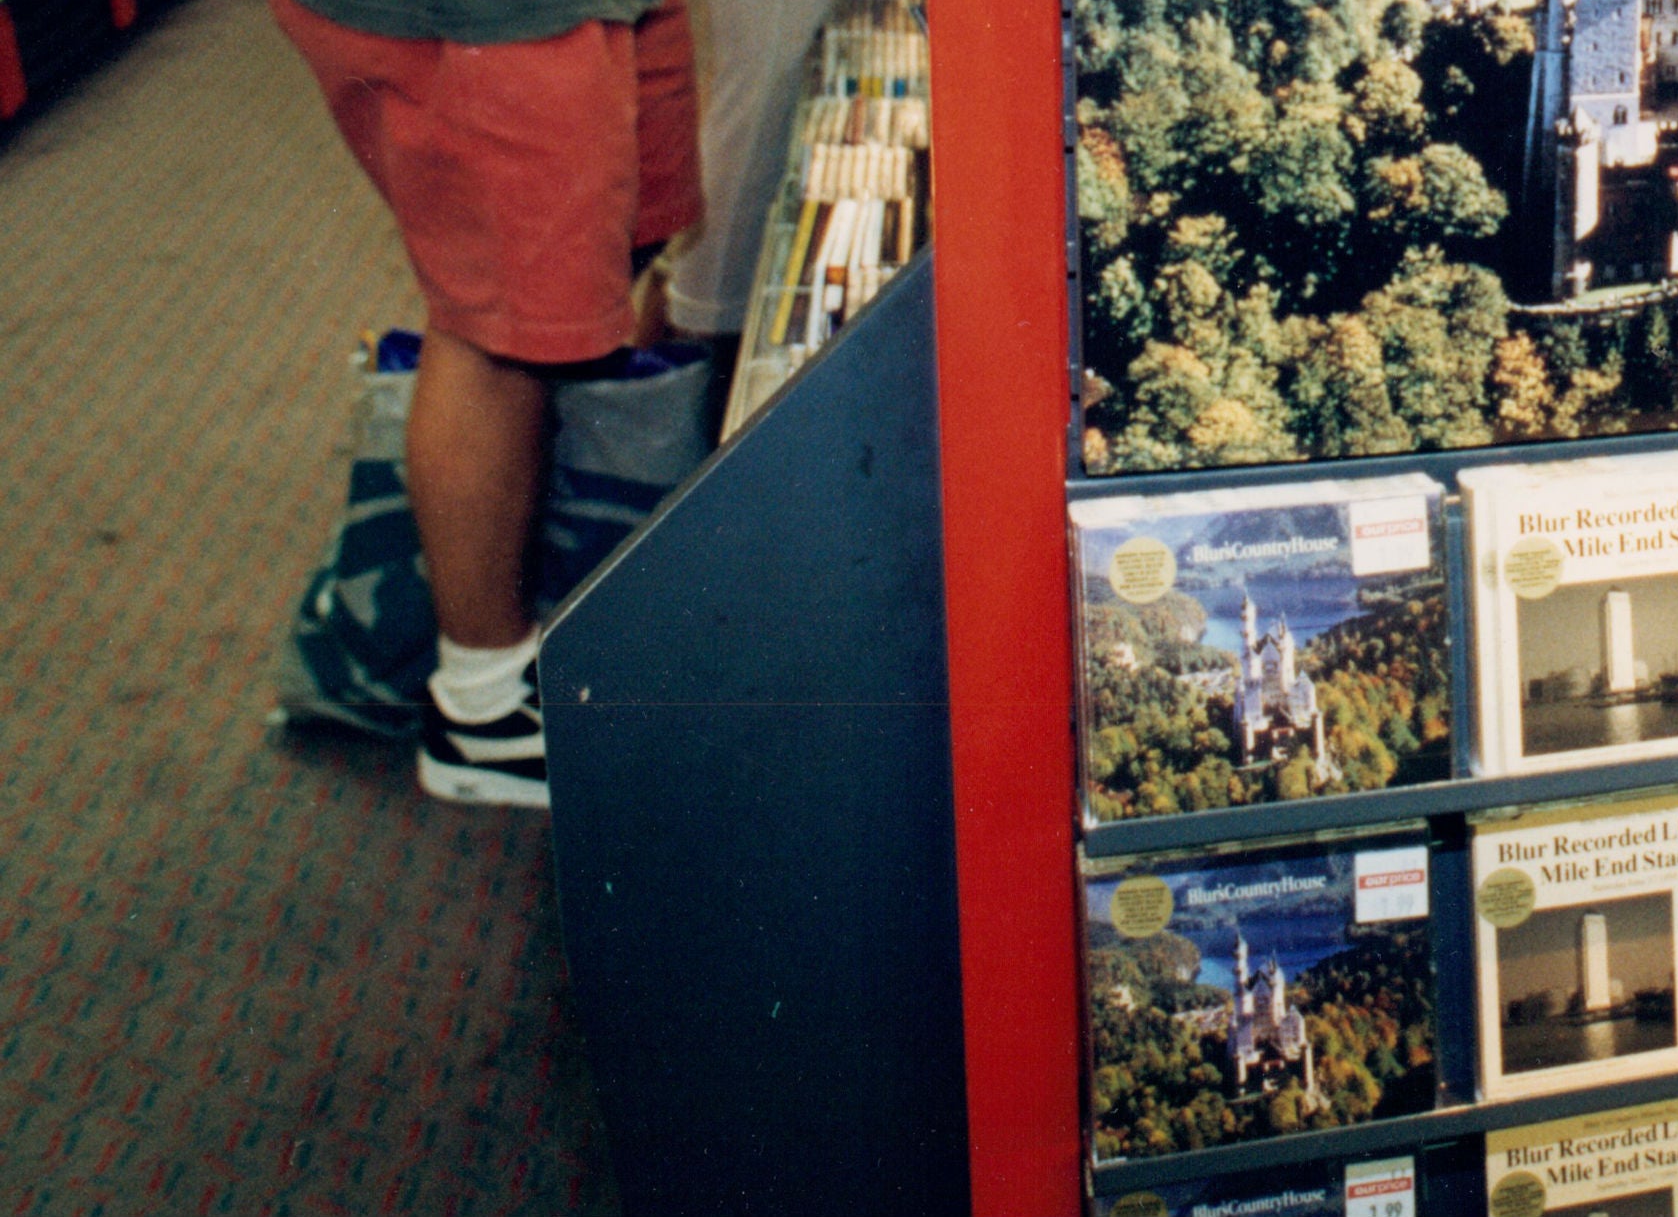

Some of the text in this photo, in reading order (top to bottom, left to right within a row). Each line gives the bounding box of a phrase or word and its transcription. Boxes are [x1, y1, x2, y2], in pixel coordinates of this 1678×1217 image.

[1518, 512, 1570, 535] Blur
[1563, 536, 1613, 558] Mile
[1619, 530, 1664, 554] End
[1498, 842, 1548, 864] Blur
[1553, 827, 1657, 856] Recorded
[1540, 862, 1590, 884] Mile
[1595, 854, 1638, 877] End
[1505, 1147, 1554, 1169] Blur
[1559, 1127, 1659, 1159] Recorded
[1548, 1163, 1594, 1186] Mile
[1598, 1153, 1640, 1177] End
[1369, 1201, 1402, 1217] 199
